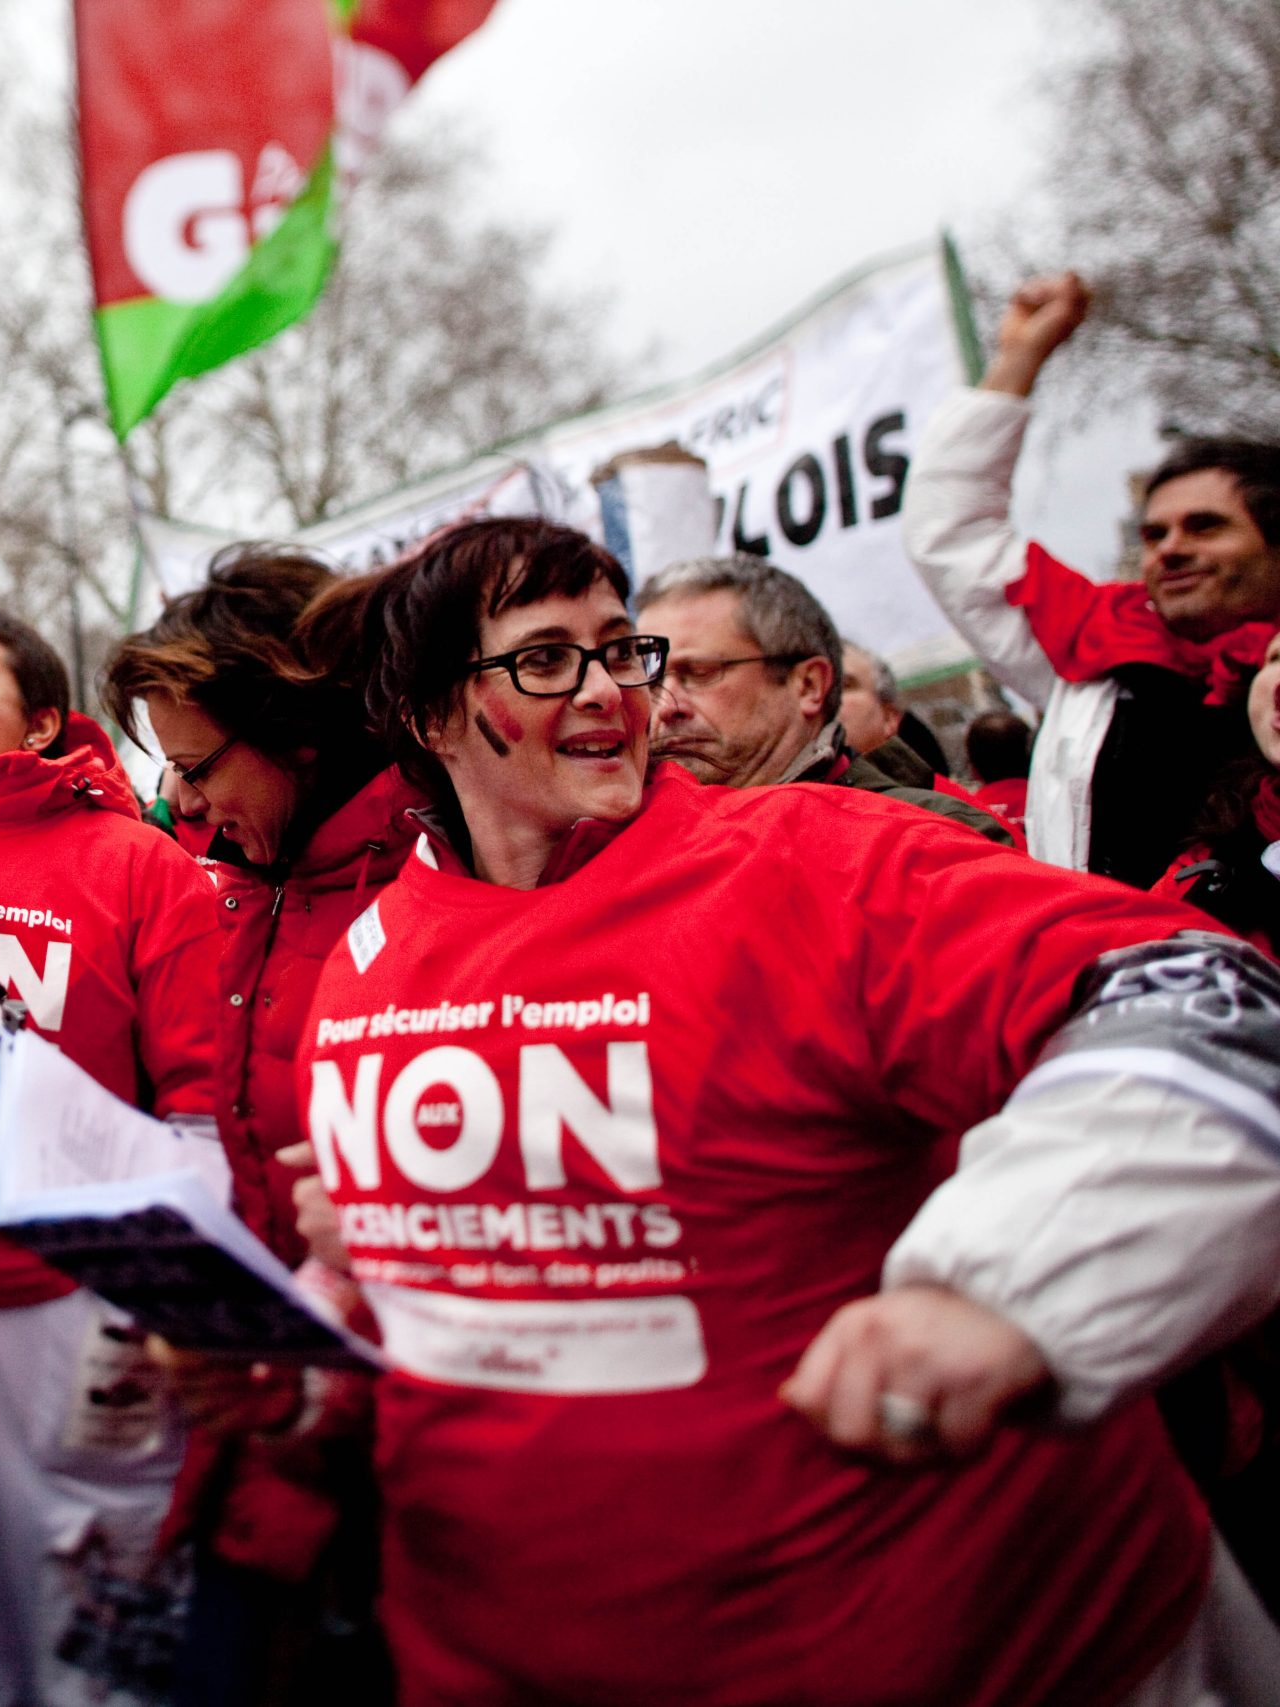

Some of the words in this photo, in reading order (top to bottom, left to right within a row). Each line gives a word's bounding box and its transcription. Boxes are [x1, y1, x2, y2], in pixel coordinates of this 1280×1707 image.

[714, 409, 911, 558] LOIS
[317, 1018, 367, 1047] Pour
[370, 1004, 493, 1038] sécuriser
[501, 992, 650, 1030] l'emploi
[310, 1041, 663, 1193] NON
[416, 1103, 461, 1126] AUX
